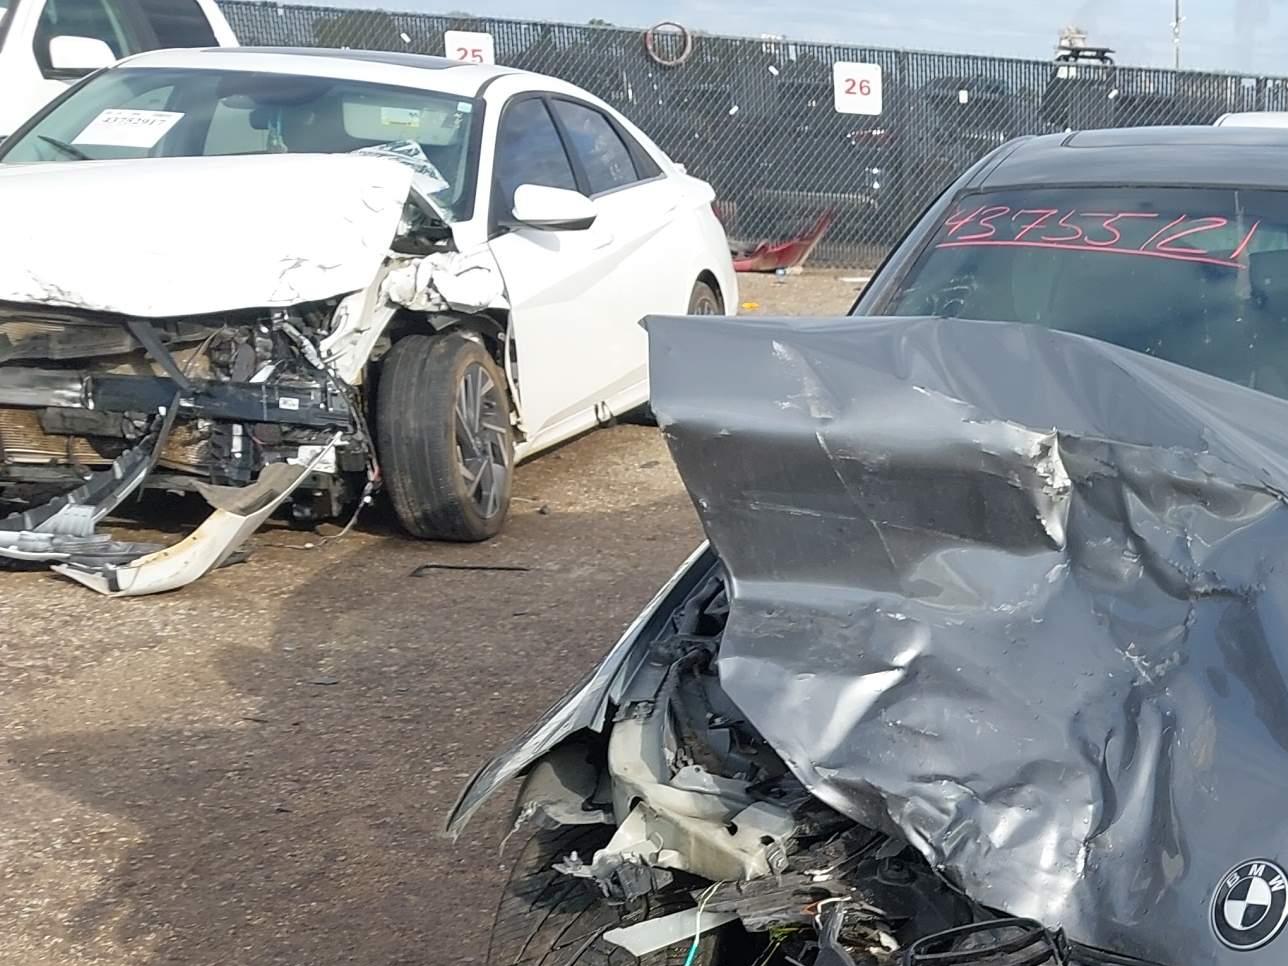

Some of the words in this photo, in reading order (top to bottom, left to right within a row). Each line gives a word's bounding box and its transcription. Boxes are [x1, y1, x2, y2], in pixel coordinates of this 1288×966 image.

[456, 47, 484, 63] 25
[844, 78, 872, 97] 26
[945, 206, 1261, 260] 43755121
[1226, 863, 1286, 892] BMW
